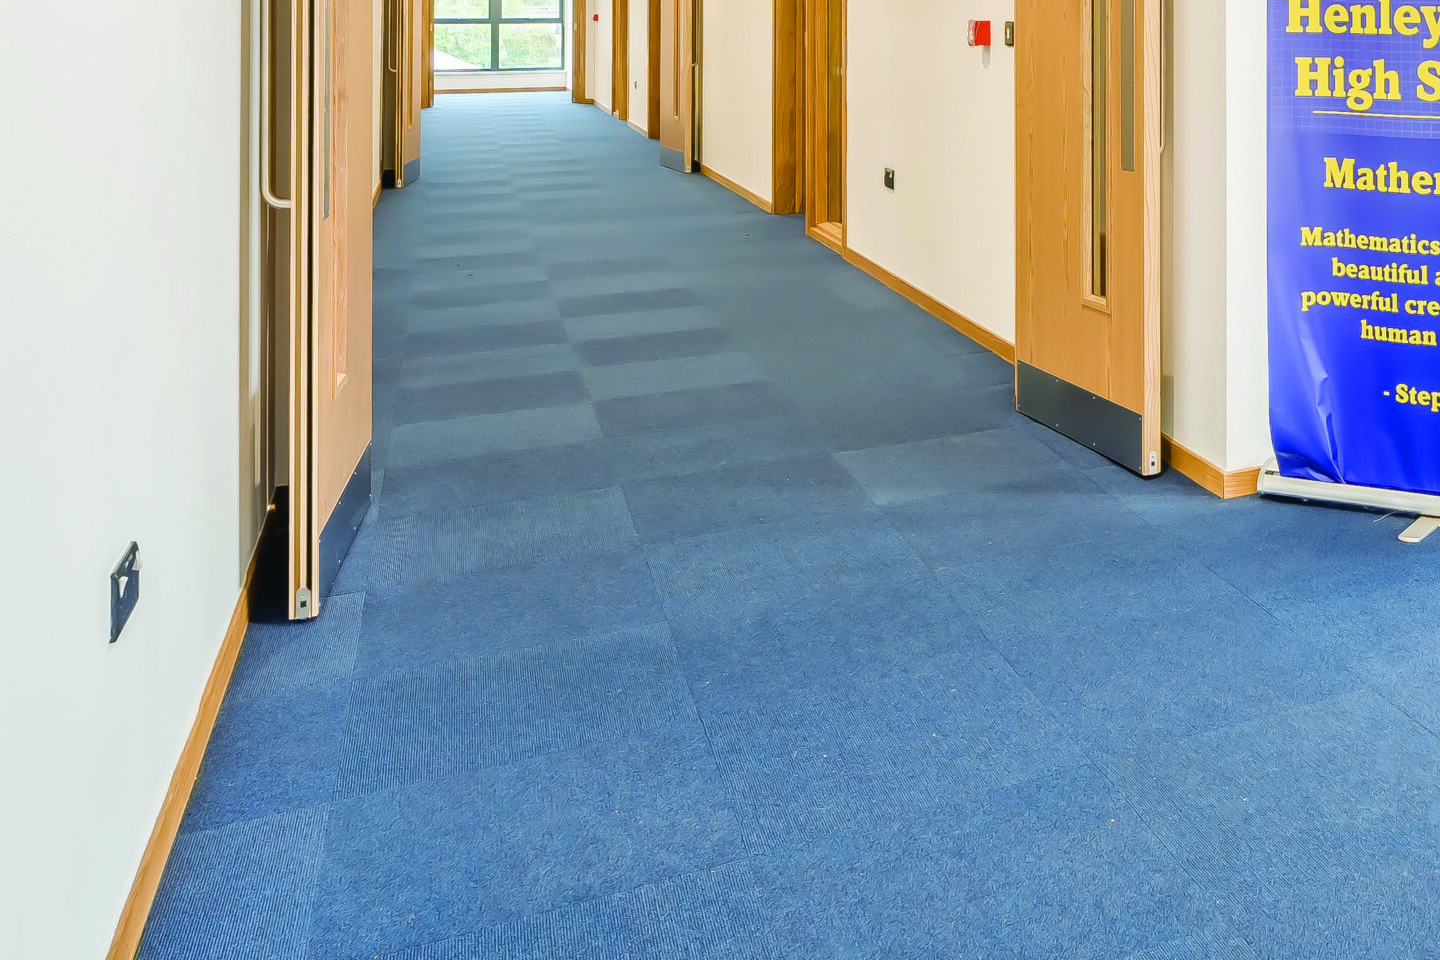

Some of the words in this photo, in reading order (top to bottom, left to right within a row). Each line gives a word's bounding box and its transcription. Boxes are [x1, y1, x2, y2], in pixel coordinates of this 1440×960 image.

[1294, 55, 1402, 112] High
[1331, 257, 1429, 286] beautiful
[1301, 290, 1399, 314] powerful
[1360, 320, 1437, 347] human
